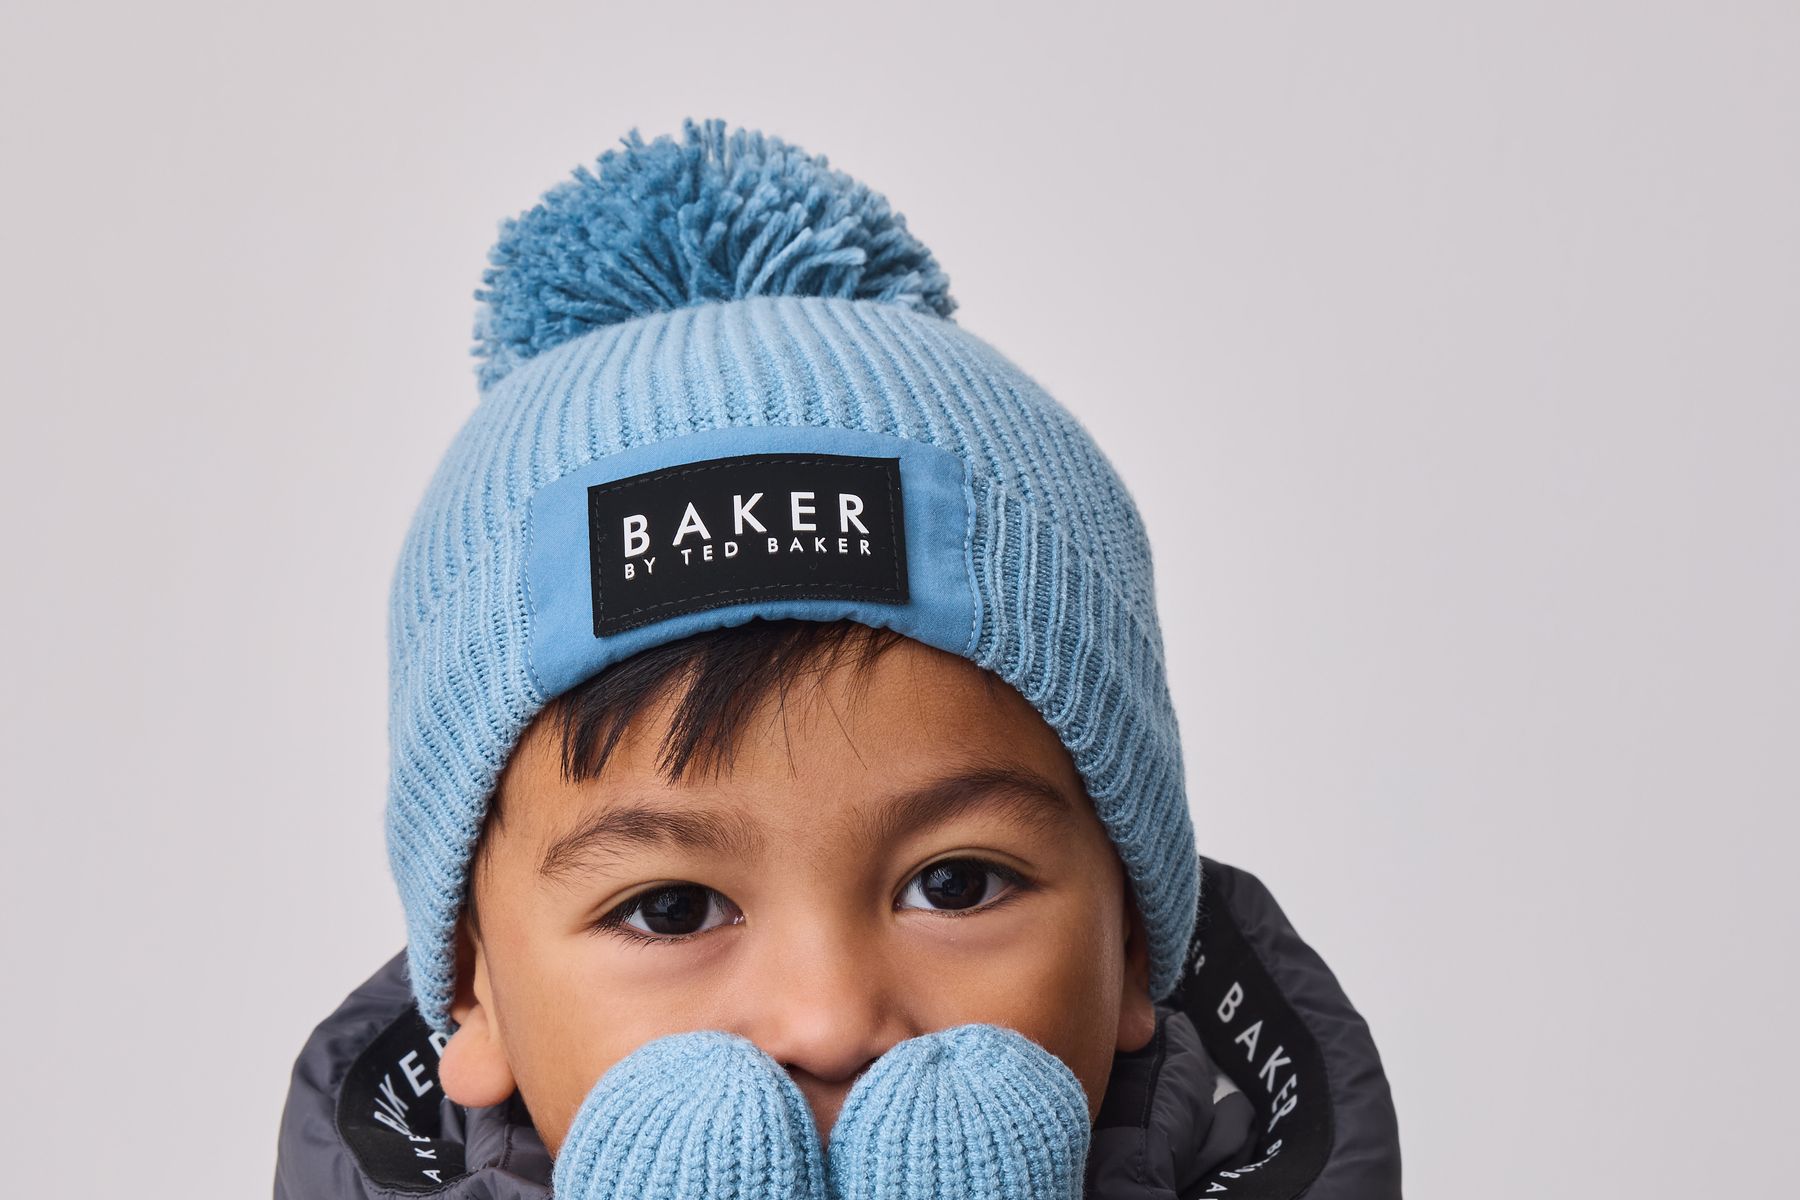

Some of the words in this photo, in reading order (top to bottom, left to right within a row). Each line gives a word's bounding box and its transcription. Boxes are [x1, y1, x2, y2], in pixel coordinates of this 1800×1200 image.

[623, 491, 870, 558] BAKER
[624, 557, 656, 580] BY
[681, 541, 739, 566] TED
[767, 537, 872, 556] BAKER
[1217, 981, 1298, 1133] BAKER
[408, 1134, 442, 1183] AKE
